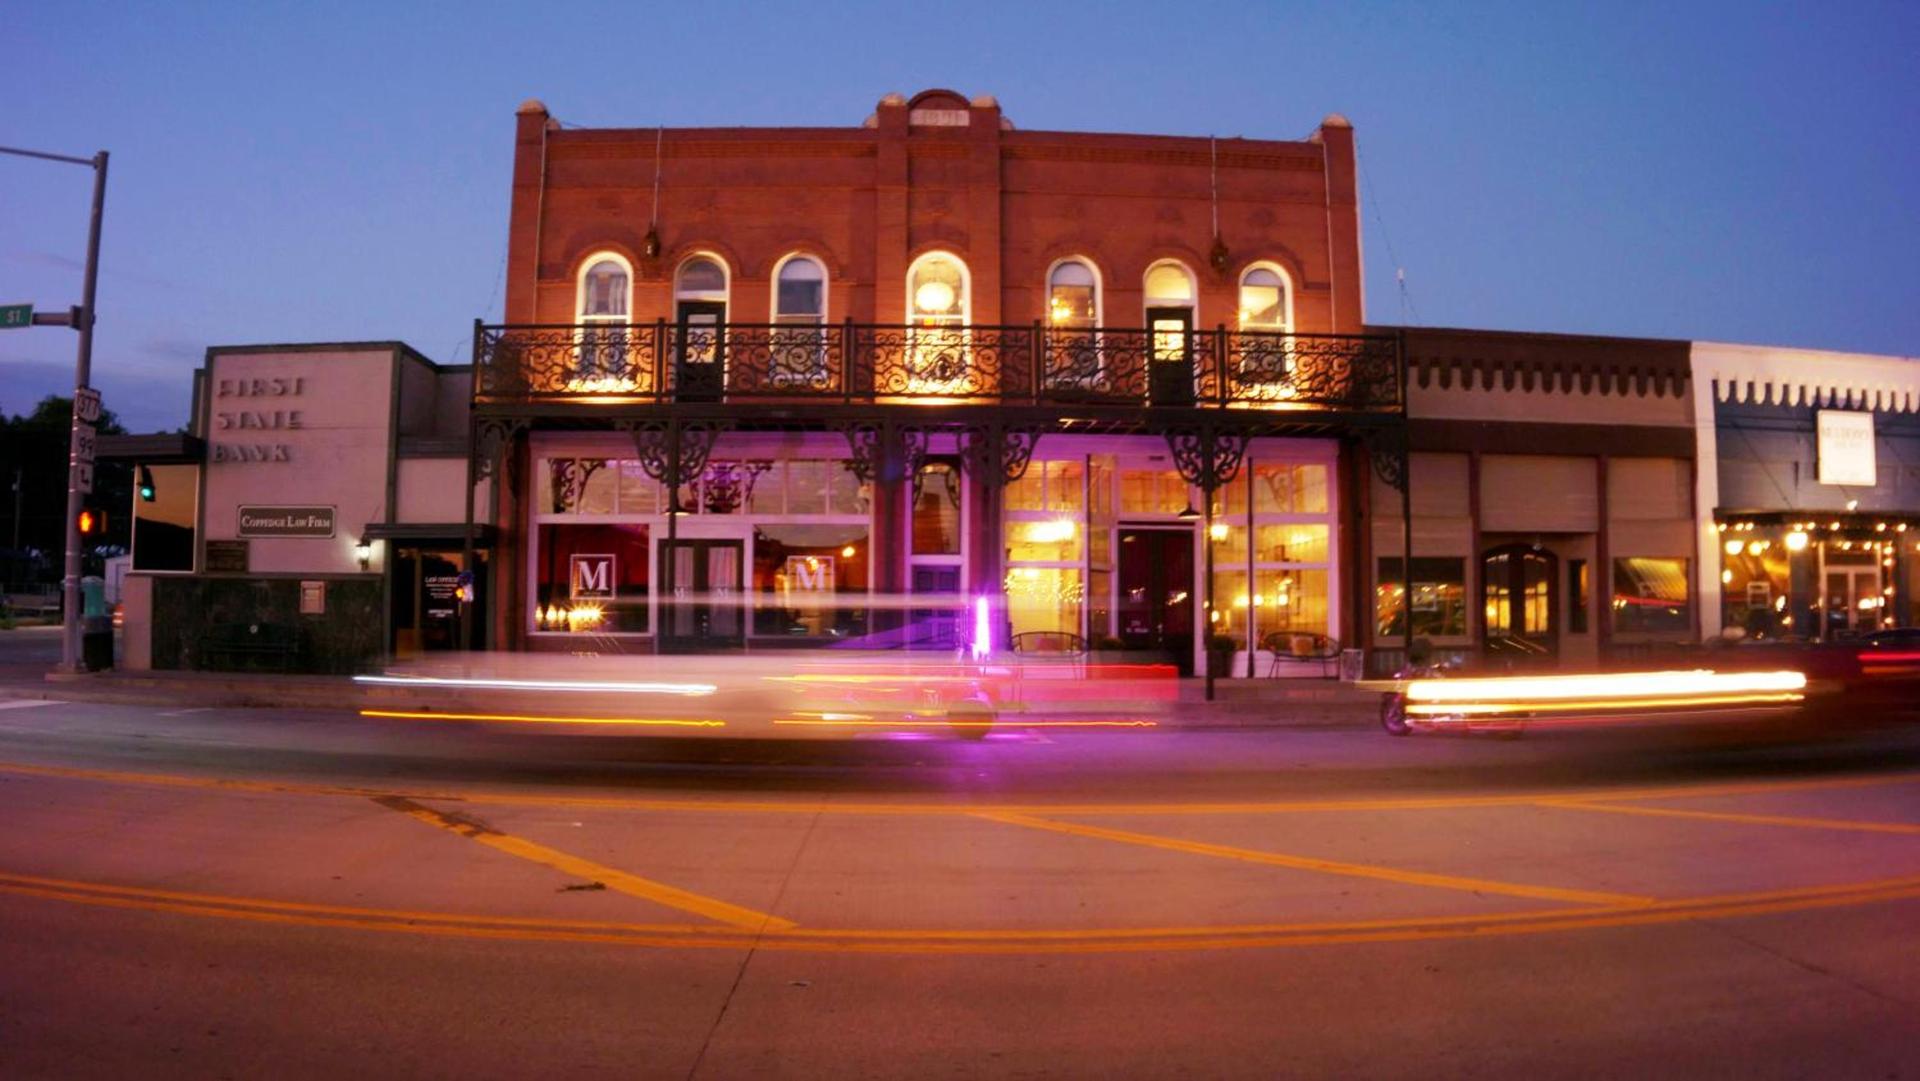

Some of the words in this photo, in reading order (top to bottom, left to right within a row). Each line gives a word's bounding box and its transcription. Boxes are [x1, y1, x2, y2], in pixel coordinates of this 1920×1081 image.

[219, 378, 305, 397] FIRST
[217, 411, 304, 430] STATE
[213, 443, 291, 463] BANK
[577, 561, 609, 591] M
[796, 563, 826, 594] M
